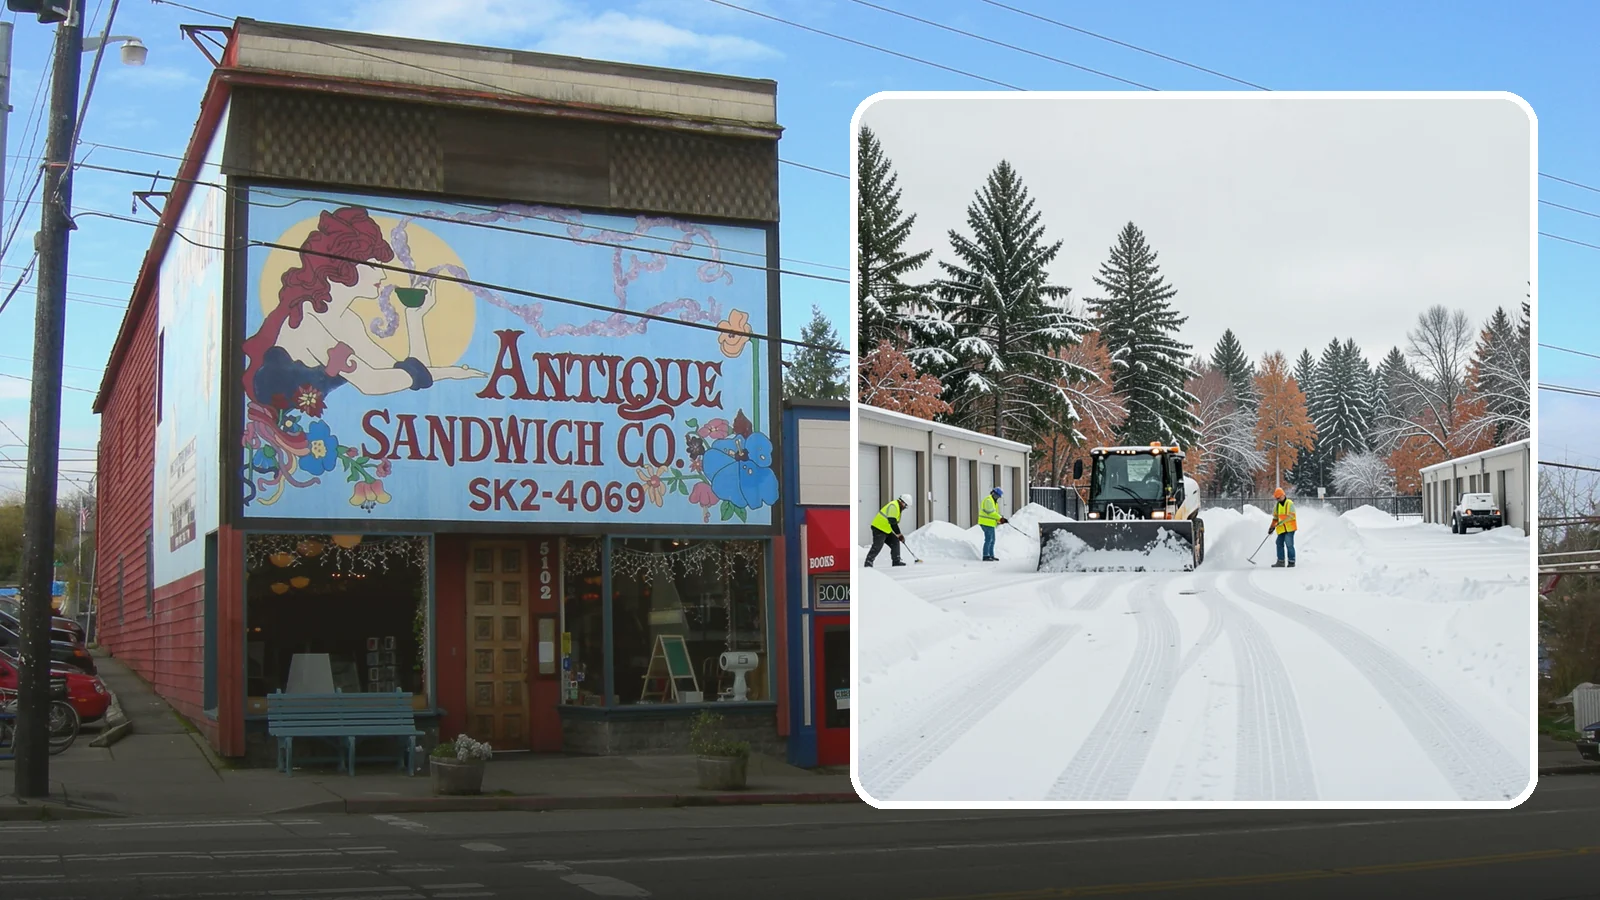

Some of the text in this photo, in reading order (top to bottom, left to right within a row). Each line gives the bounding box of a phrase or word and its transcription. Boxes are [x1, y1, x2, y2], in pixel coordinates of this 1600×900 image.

[475, 328, 724, 421] ANTIQUE
[362, 408, 685, 468] SANDWICH CO.
[468, 477, 645, 513] SK2-4069
[539, 541, 552, 600] 5102
[809, 555, 835, 569] BOOKS
